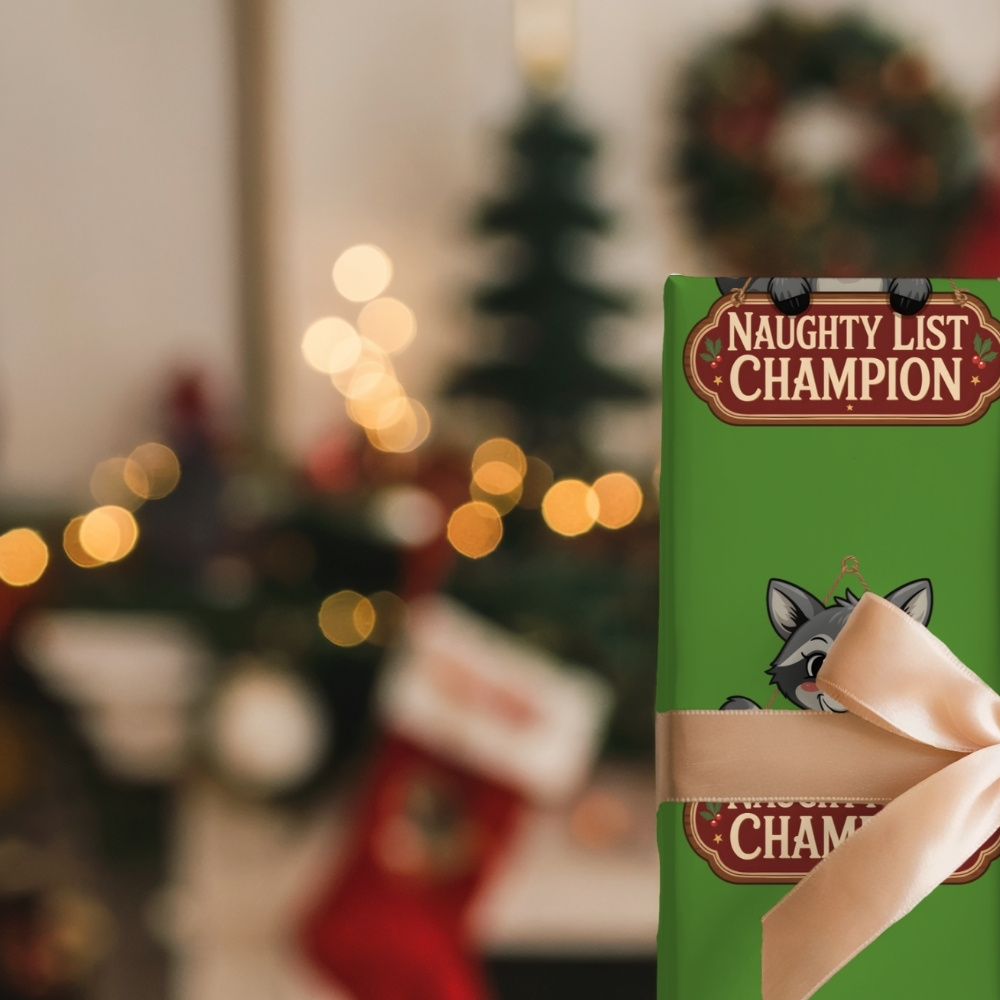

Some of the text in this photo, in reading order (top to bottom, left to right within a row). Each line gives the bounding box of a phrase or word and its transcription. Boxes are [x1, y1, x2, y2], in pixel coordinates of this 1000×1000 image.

[727, 311, 969, 351] NAUGHTY LIST
[729, 354, 963, 402] CHAMPION
[729, 812, 875, 860] CHAM
